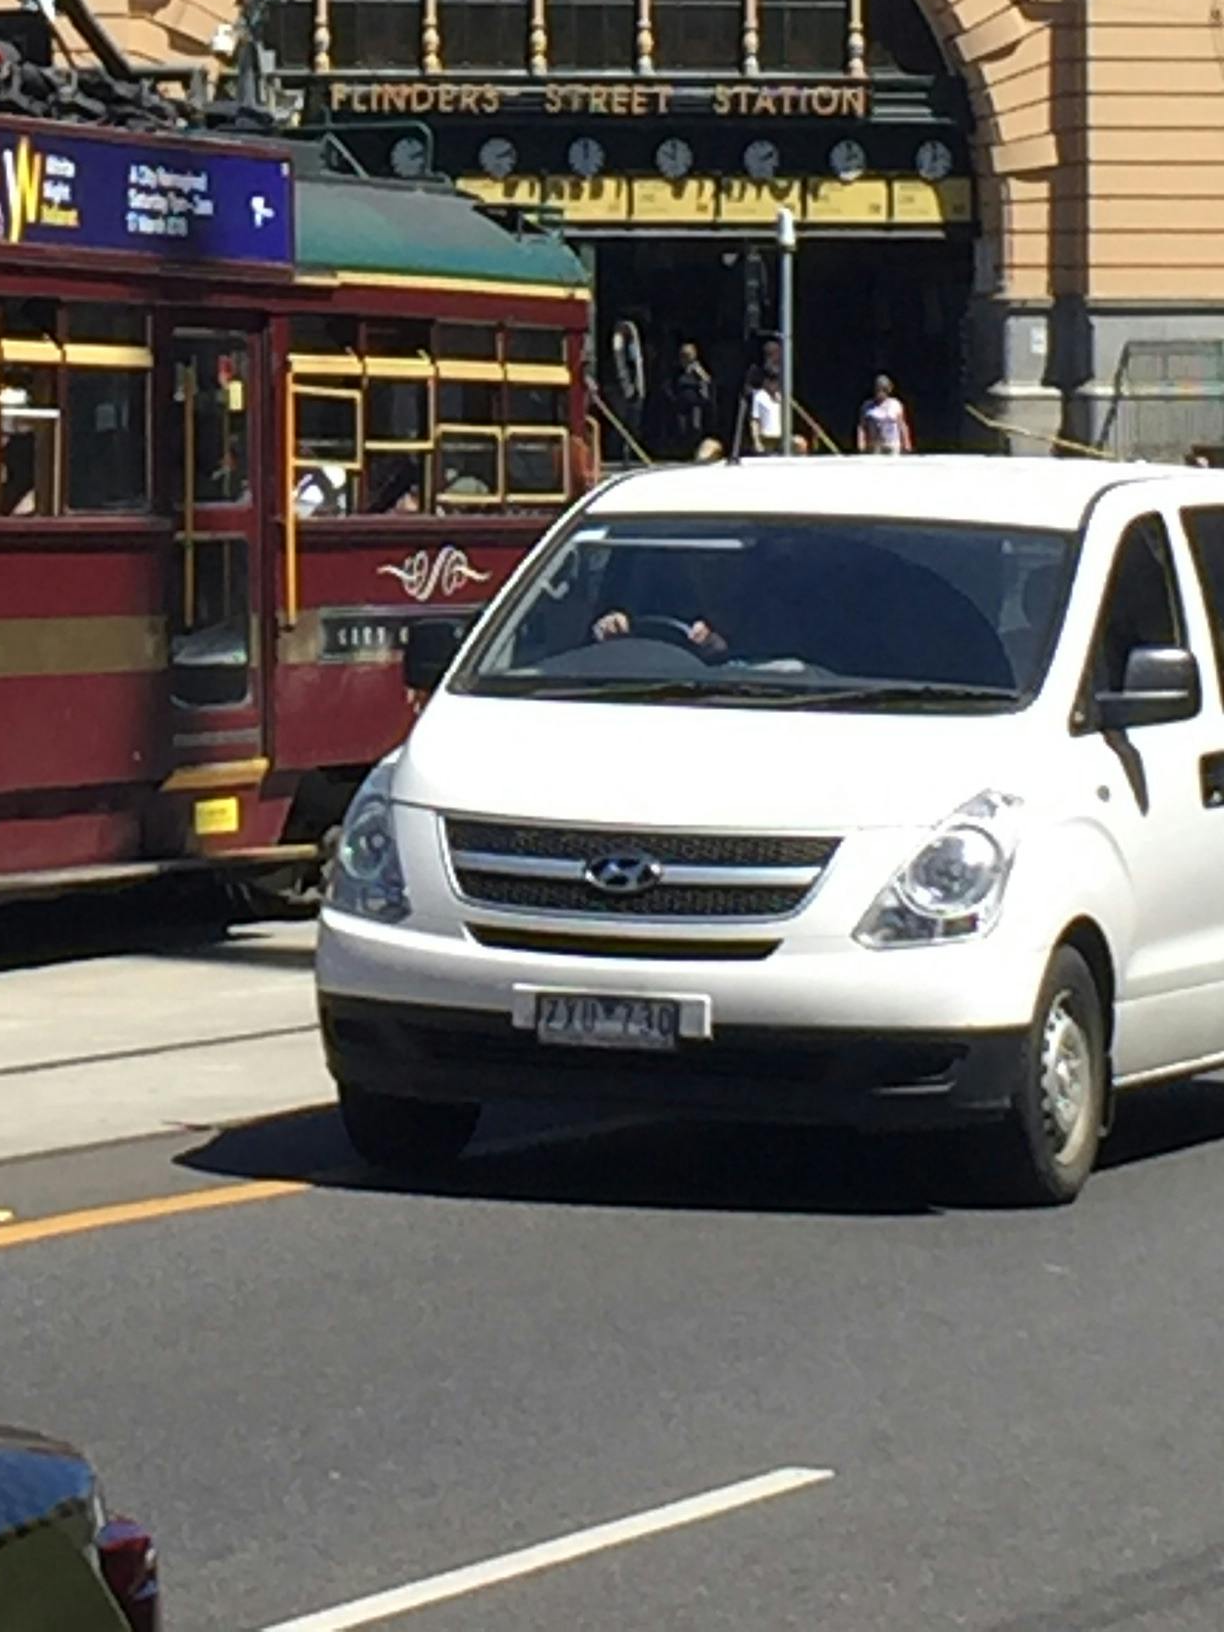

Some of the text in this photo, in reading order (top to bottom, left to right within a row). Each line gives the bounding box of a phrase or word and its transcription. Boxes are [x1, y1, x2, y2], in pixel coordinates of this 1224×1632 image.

[330, 83, 868, 117] FLINDERS STREET STATION
